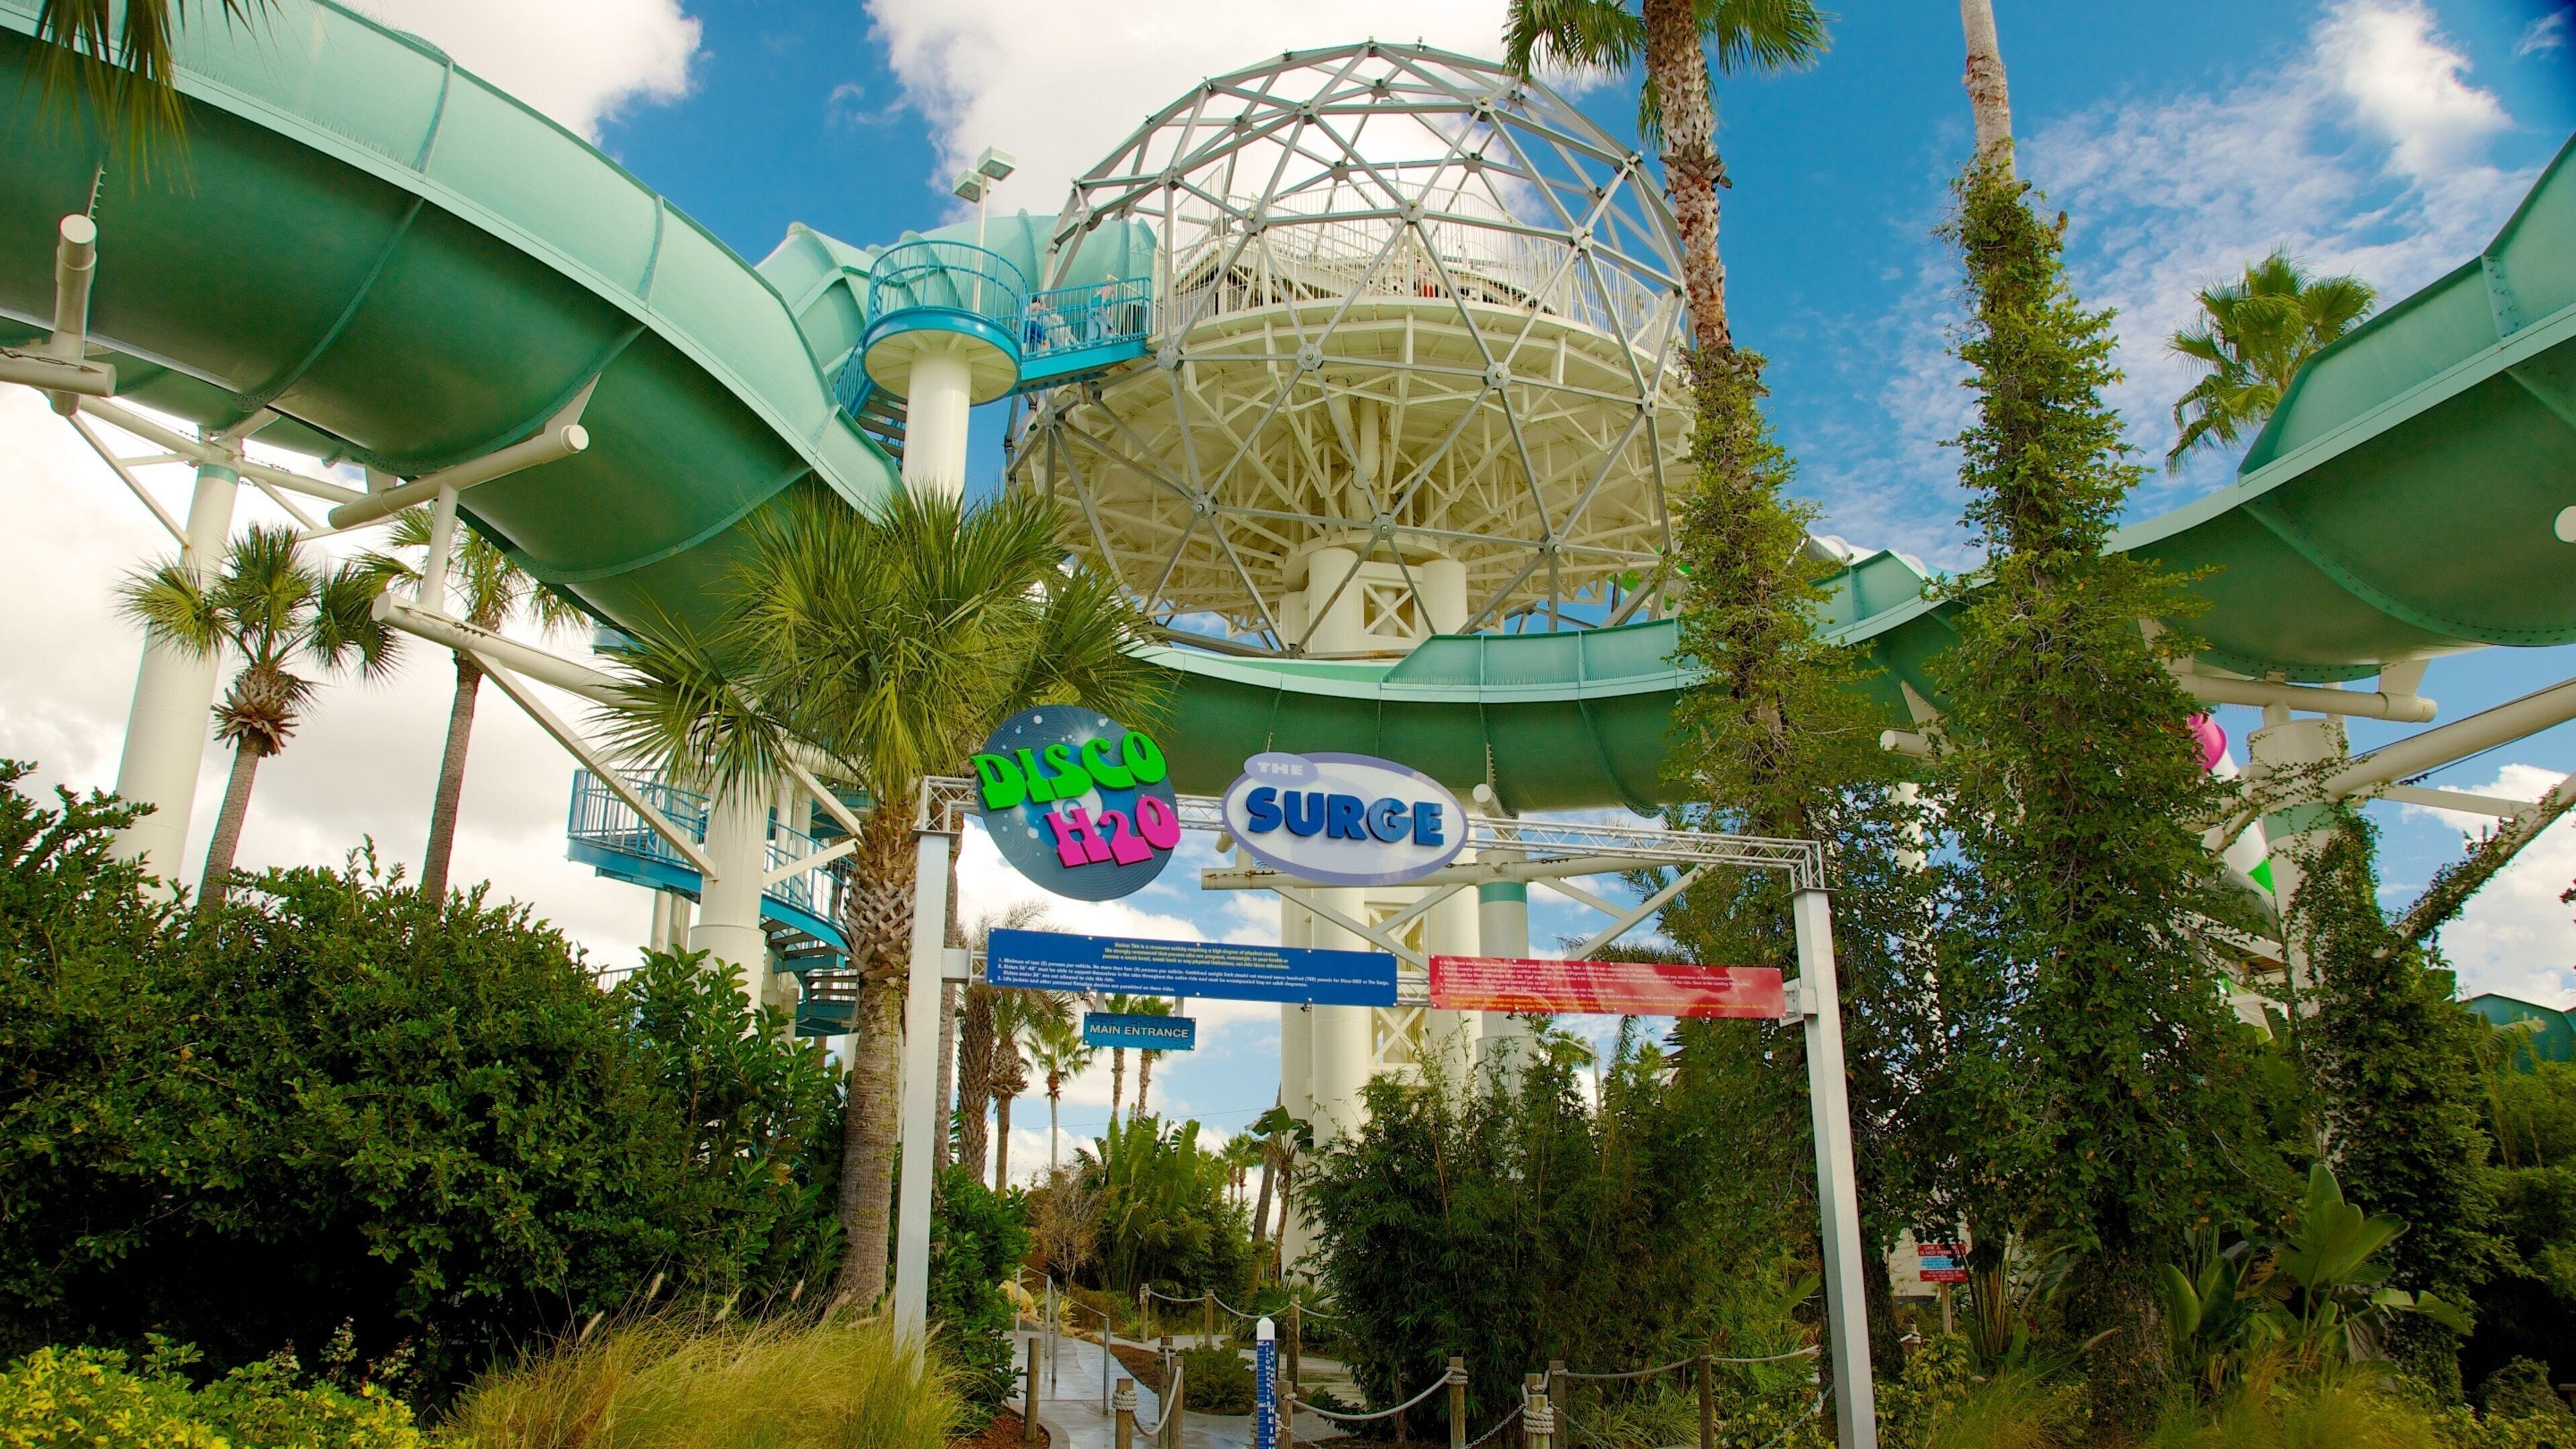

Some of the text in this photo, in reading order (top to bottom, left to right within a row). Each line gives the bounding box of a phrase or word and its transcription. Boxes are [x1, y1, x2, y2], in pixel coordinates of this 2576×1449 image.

[970, 731, 1168, 812] DISCO
[1257, 762, 1303, 776] THE
[1044, 796, 1181, 868] H2O
[1246, 787, 1444, 847] SURGE
[1090, 1025, 1189, 1038] MAIN ENTRANCE
